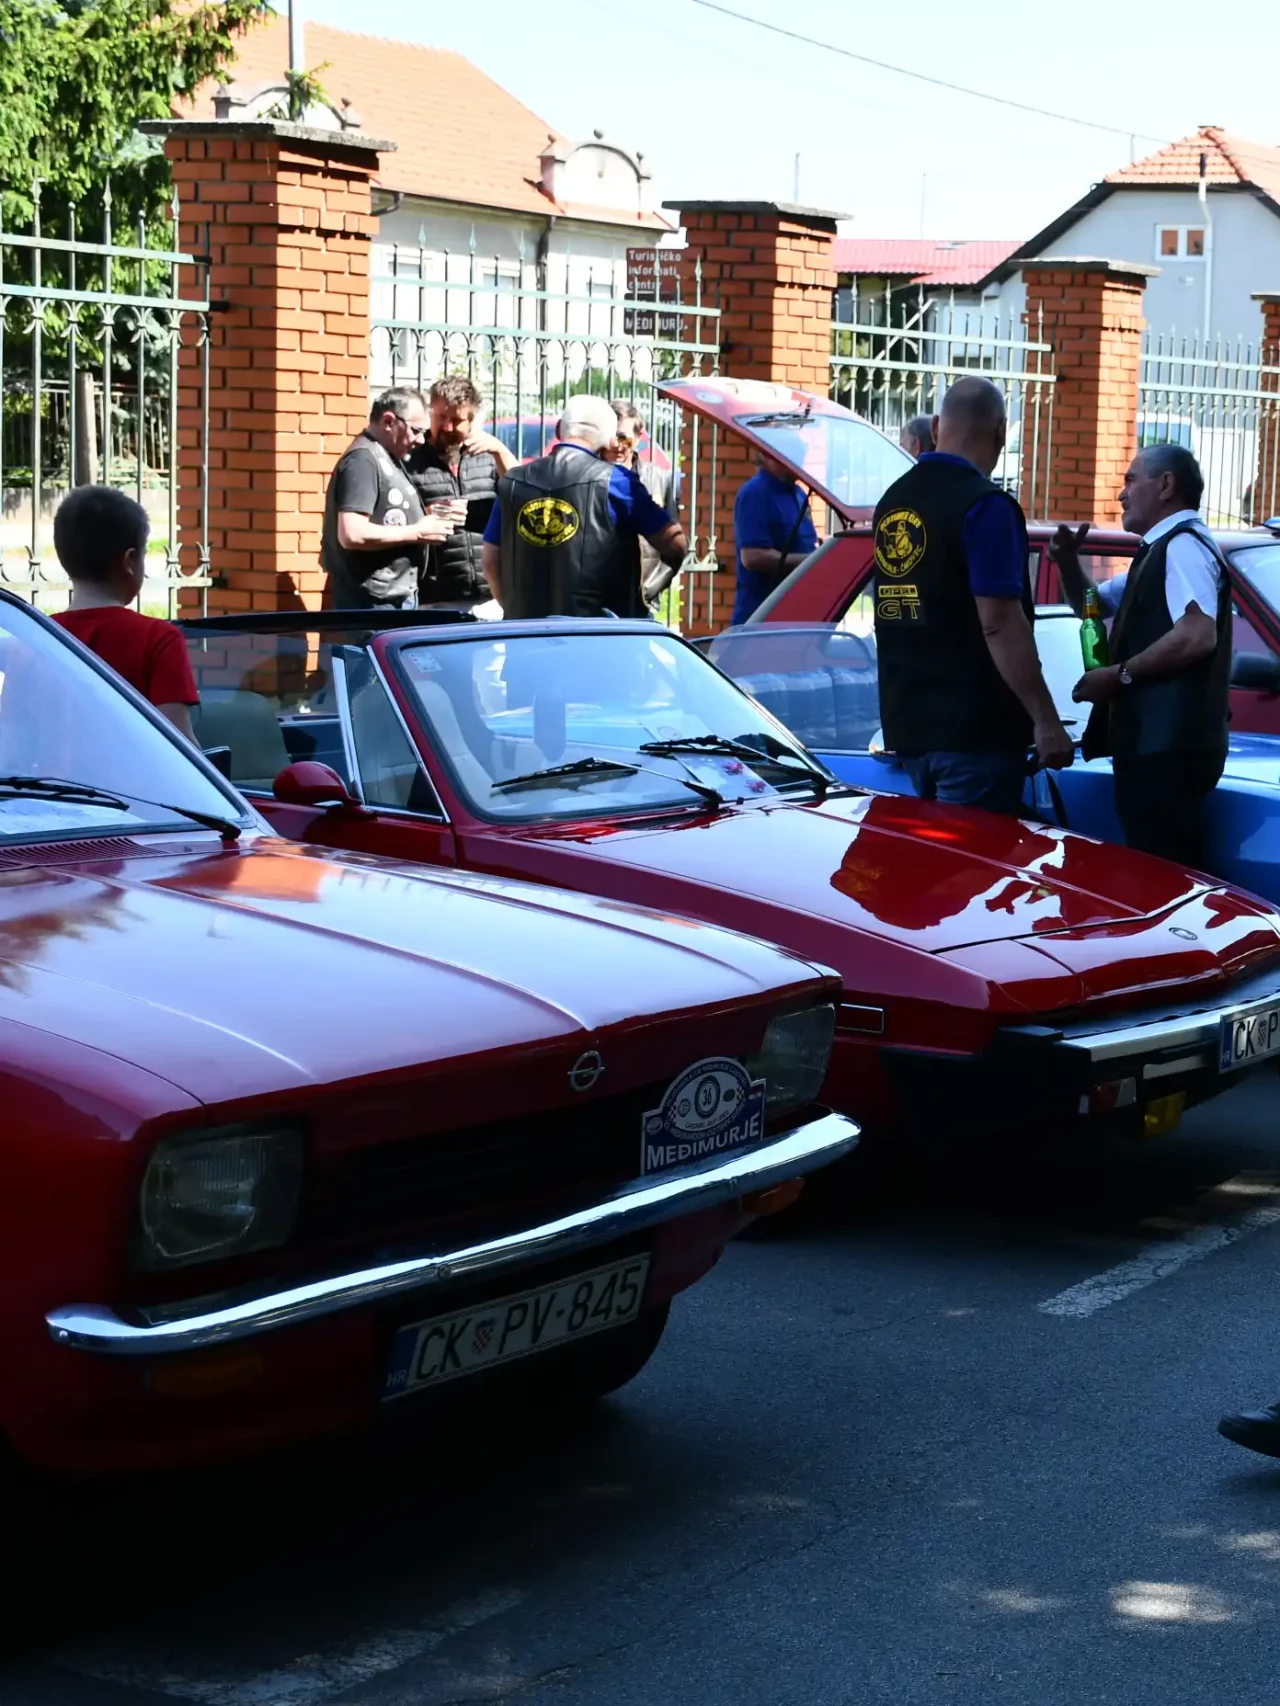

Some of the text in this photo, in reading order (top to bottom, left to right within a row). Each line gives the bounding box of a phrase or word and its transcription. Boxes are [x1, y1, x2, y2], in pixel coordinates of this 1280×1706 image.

[629, 250, 682, 261] Turisičko
[877, 598, 921, 620] GT
[1234, 1018, 1257, 1060] CK
[703, 1087, 712, 1106] 36
[647, 1112, 760, 1170] MEĐIMURJE
[415, 1318, 473, 1380] CK
[496, 1264, 643, 1356] PV-845
